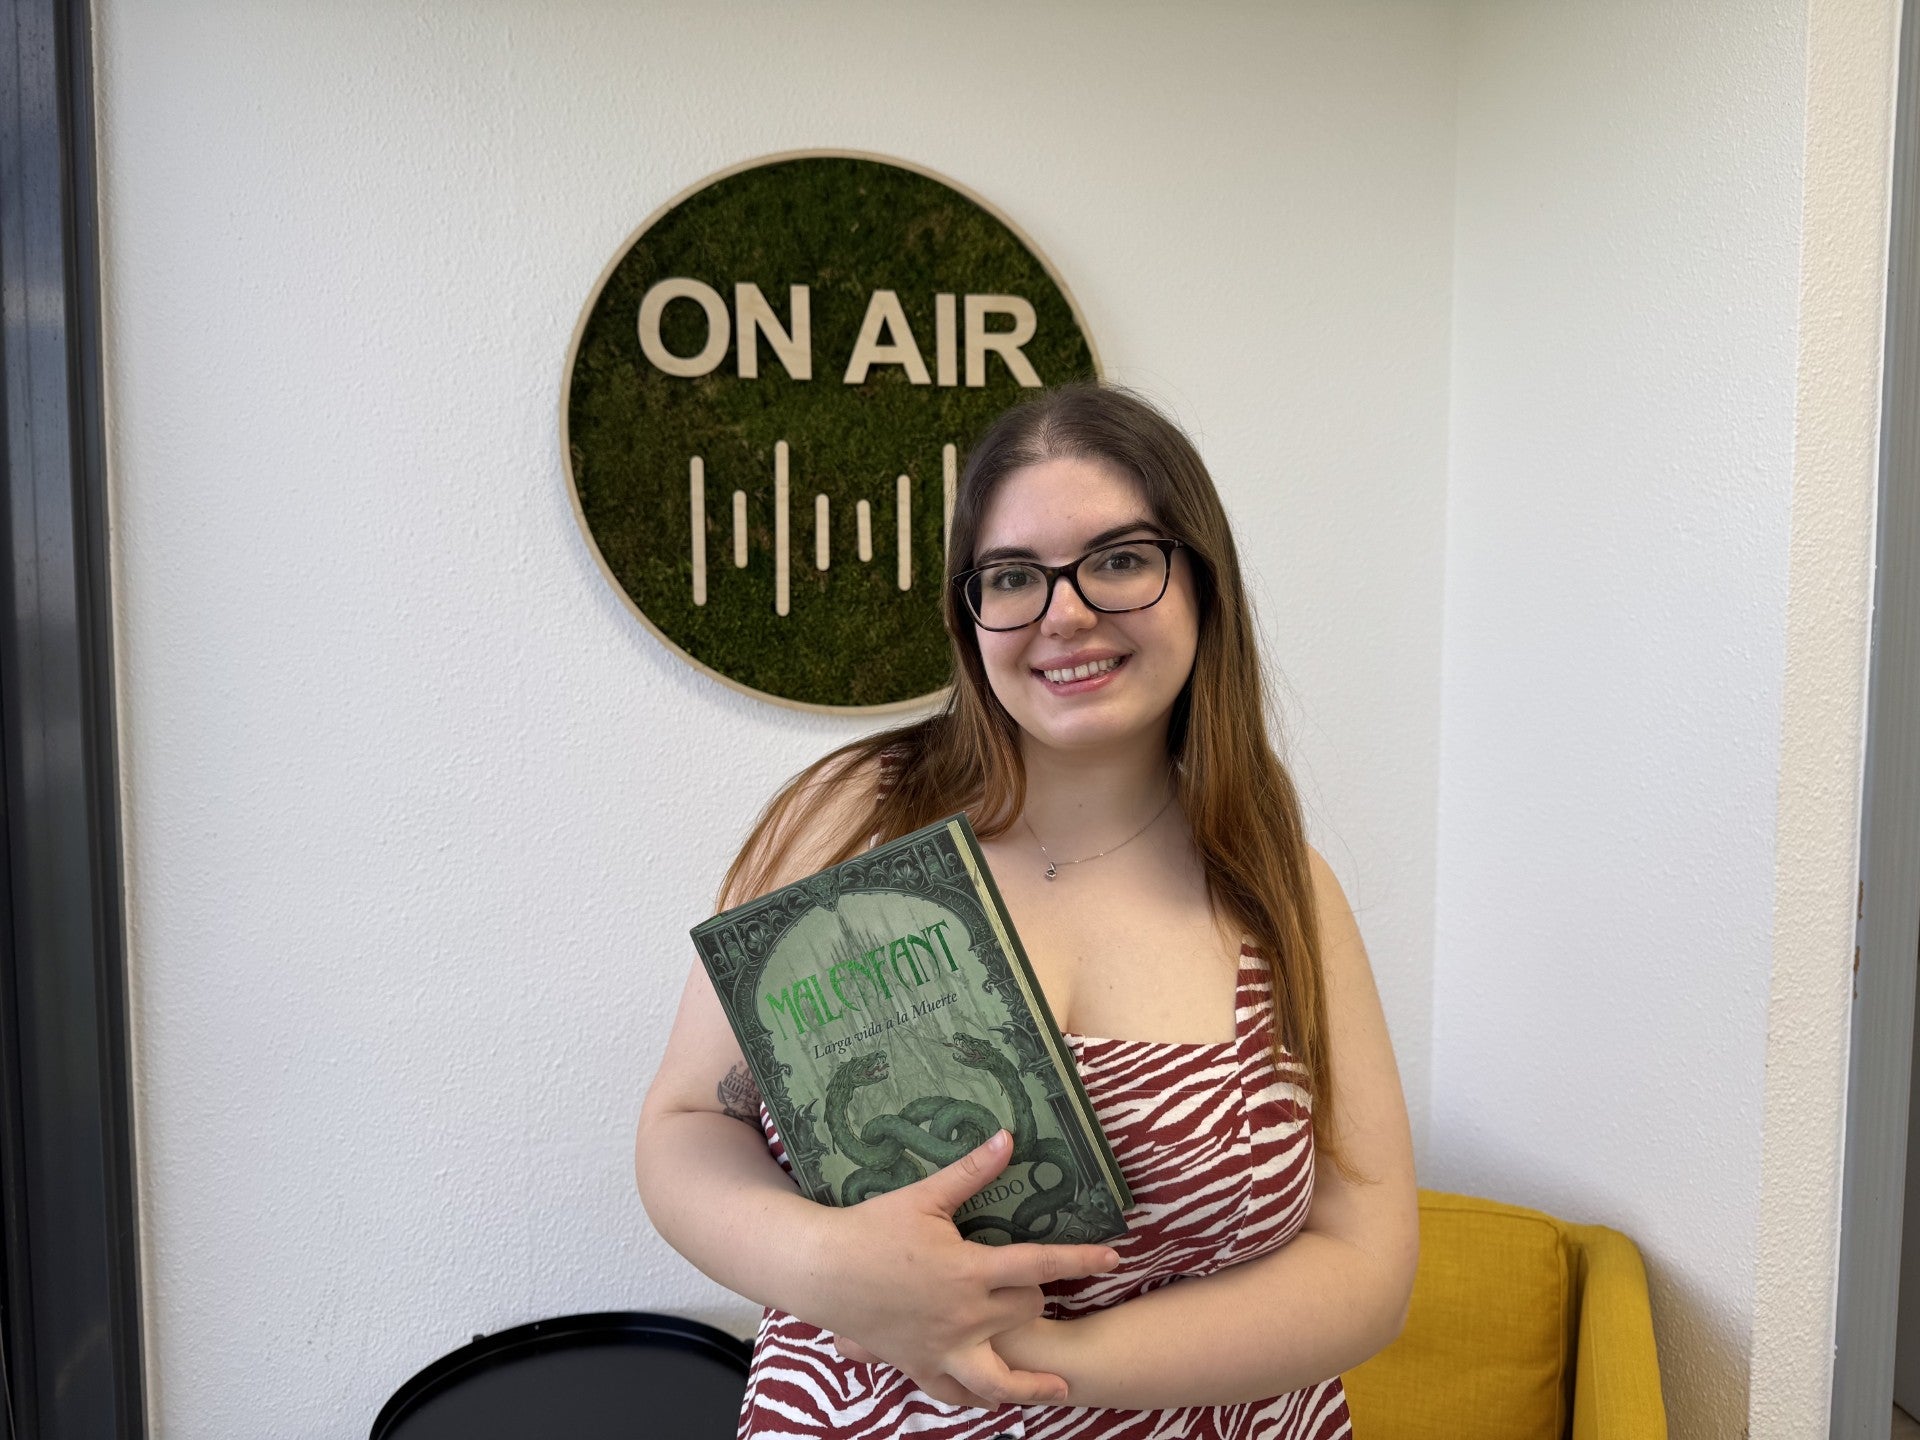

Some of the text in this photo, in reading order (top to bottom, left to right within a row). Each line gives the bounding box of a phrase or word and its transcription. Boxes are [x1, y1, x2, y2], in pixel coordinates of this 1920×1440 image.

[637, 277, 1043, 387] ON AIR
[765, 919, 959, 1040] MALENFANT
[813, 992, 958, 1059] Larga vida a la Muerte
[954, 1179, 1025, 1217] IERDO
